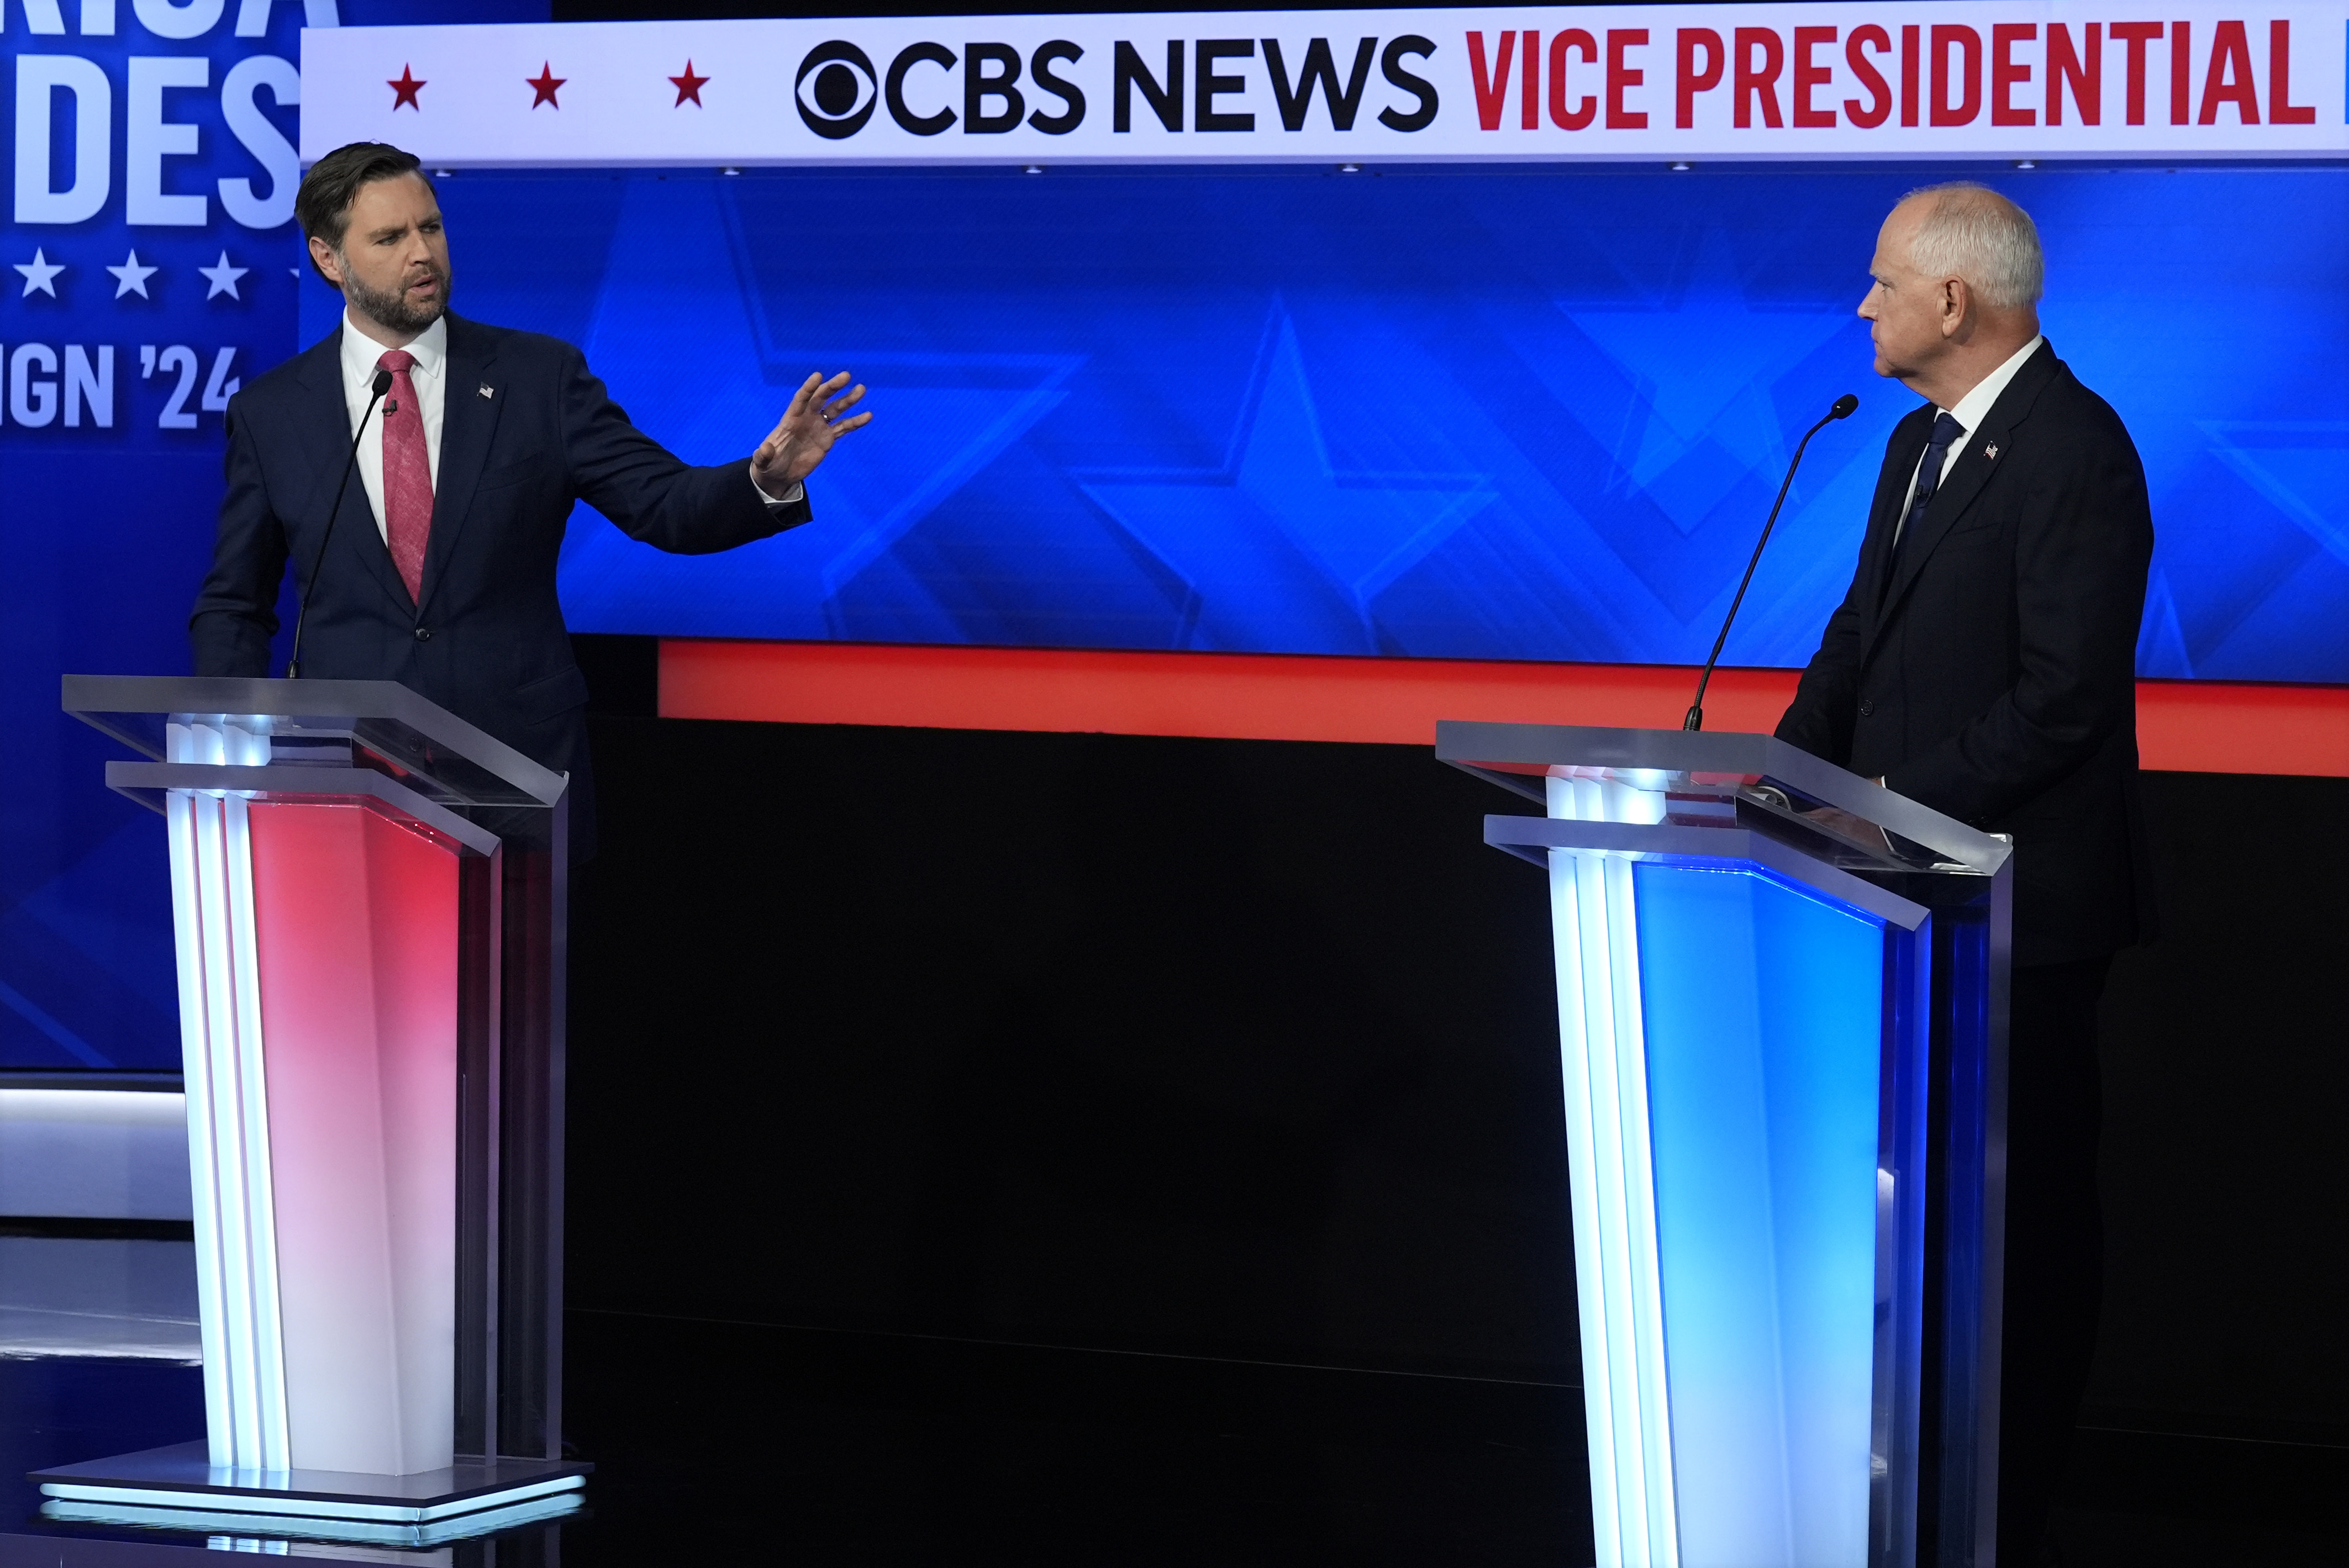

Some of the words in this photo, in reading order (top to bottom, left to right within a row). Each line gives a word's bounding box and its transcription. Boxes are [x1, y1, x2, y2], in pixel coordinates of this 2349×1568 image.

[885, 40, 1086, 136] CBS
[1114, 34, 1439, 133] NEWS
[1466, 29, 1649, 131] VICE
[1676, 20, 2316, 129] PRESIDENTIAL
[14, 54, 301, 229] DES
[0, 342, 114, 427] GN
